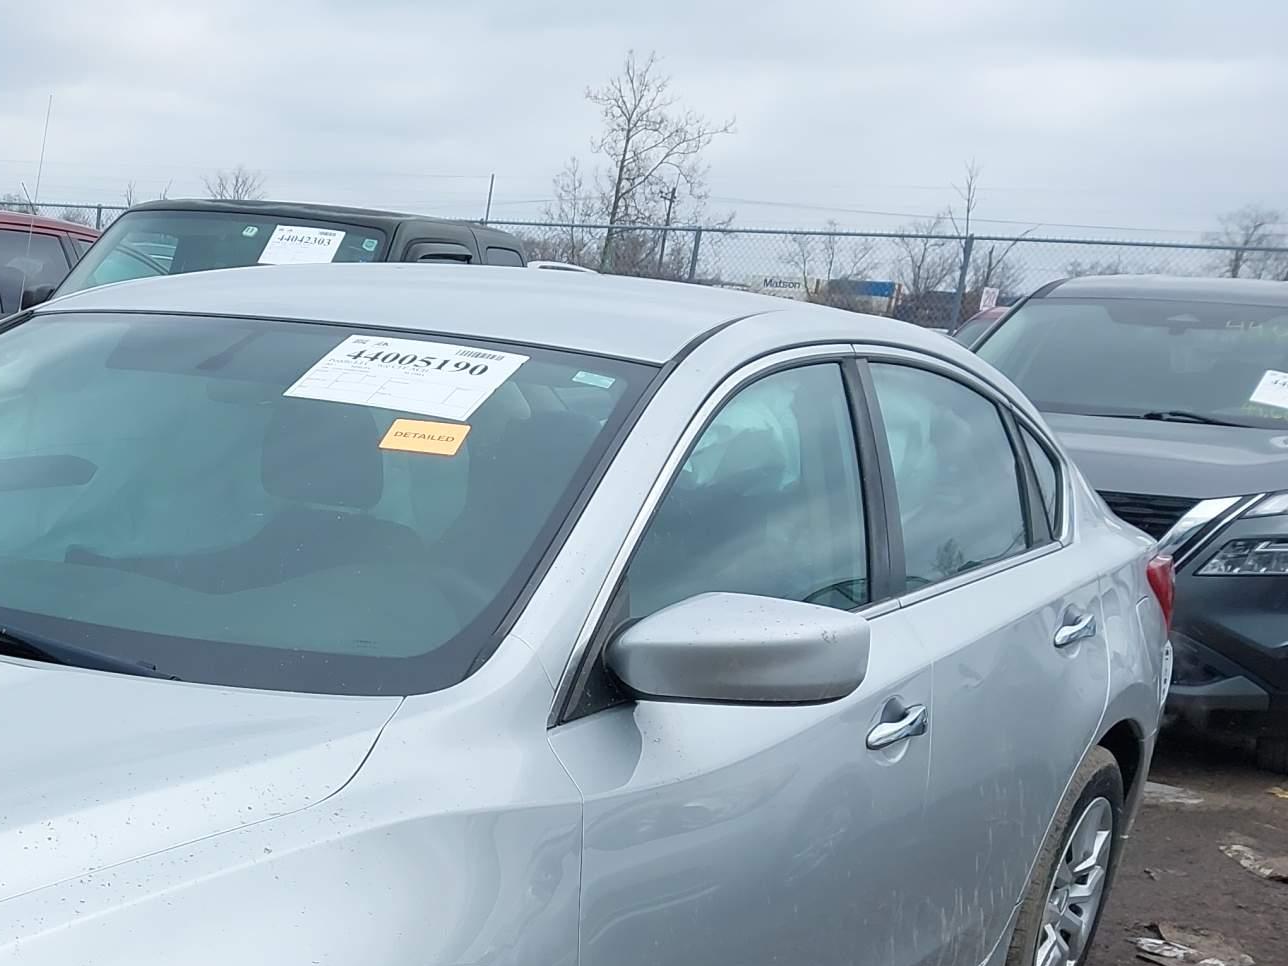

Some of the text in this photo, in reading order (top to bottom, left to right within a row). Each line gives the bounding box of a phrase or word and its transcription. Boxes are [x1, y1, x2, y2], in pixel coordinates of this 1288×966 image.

[277, 233, 332, 247] 44042303
[763, 278, 801, 289] Matson
[346, 348, 489, 377] 44005190
[393, 430, 456, 444] DETAILED
